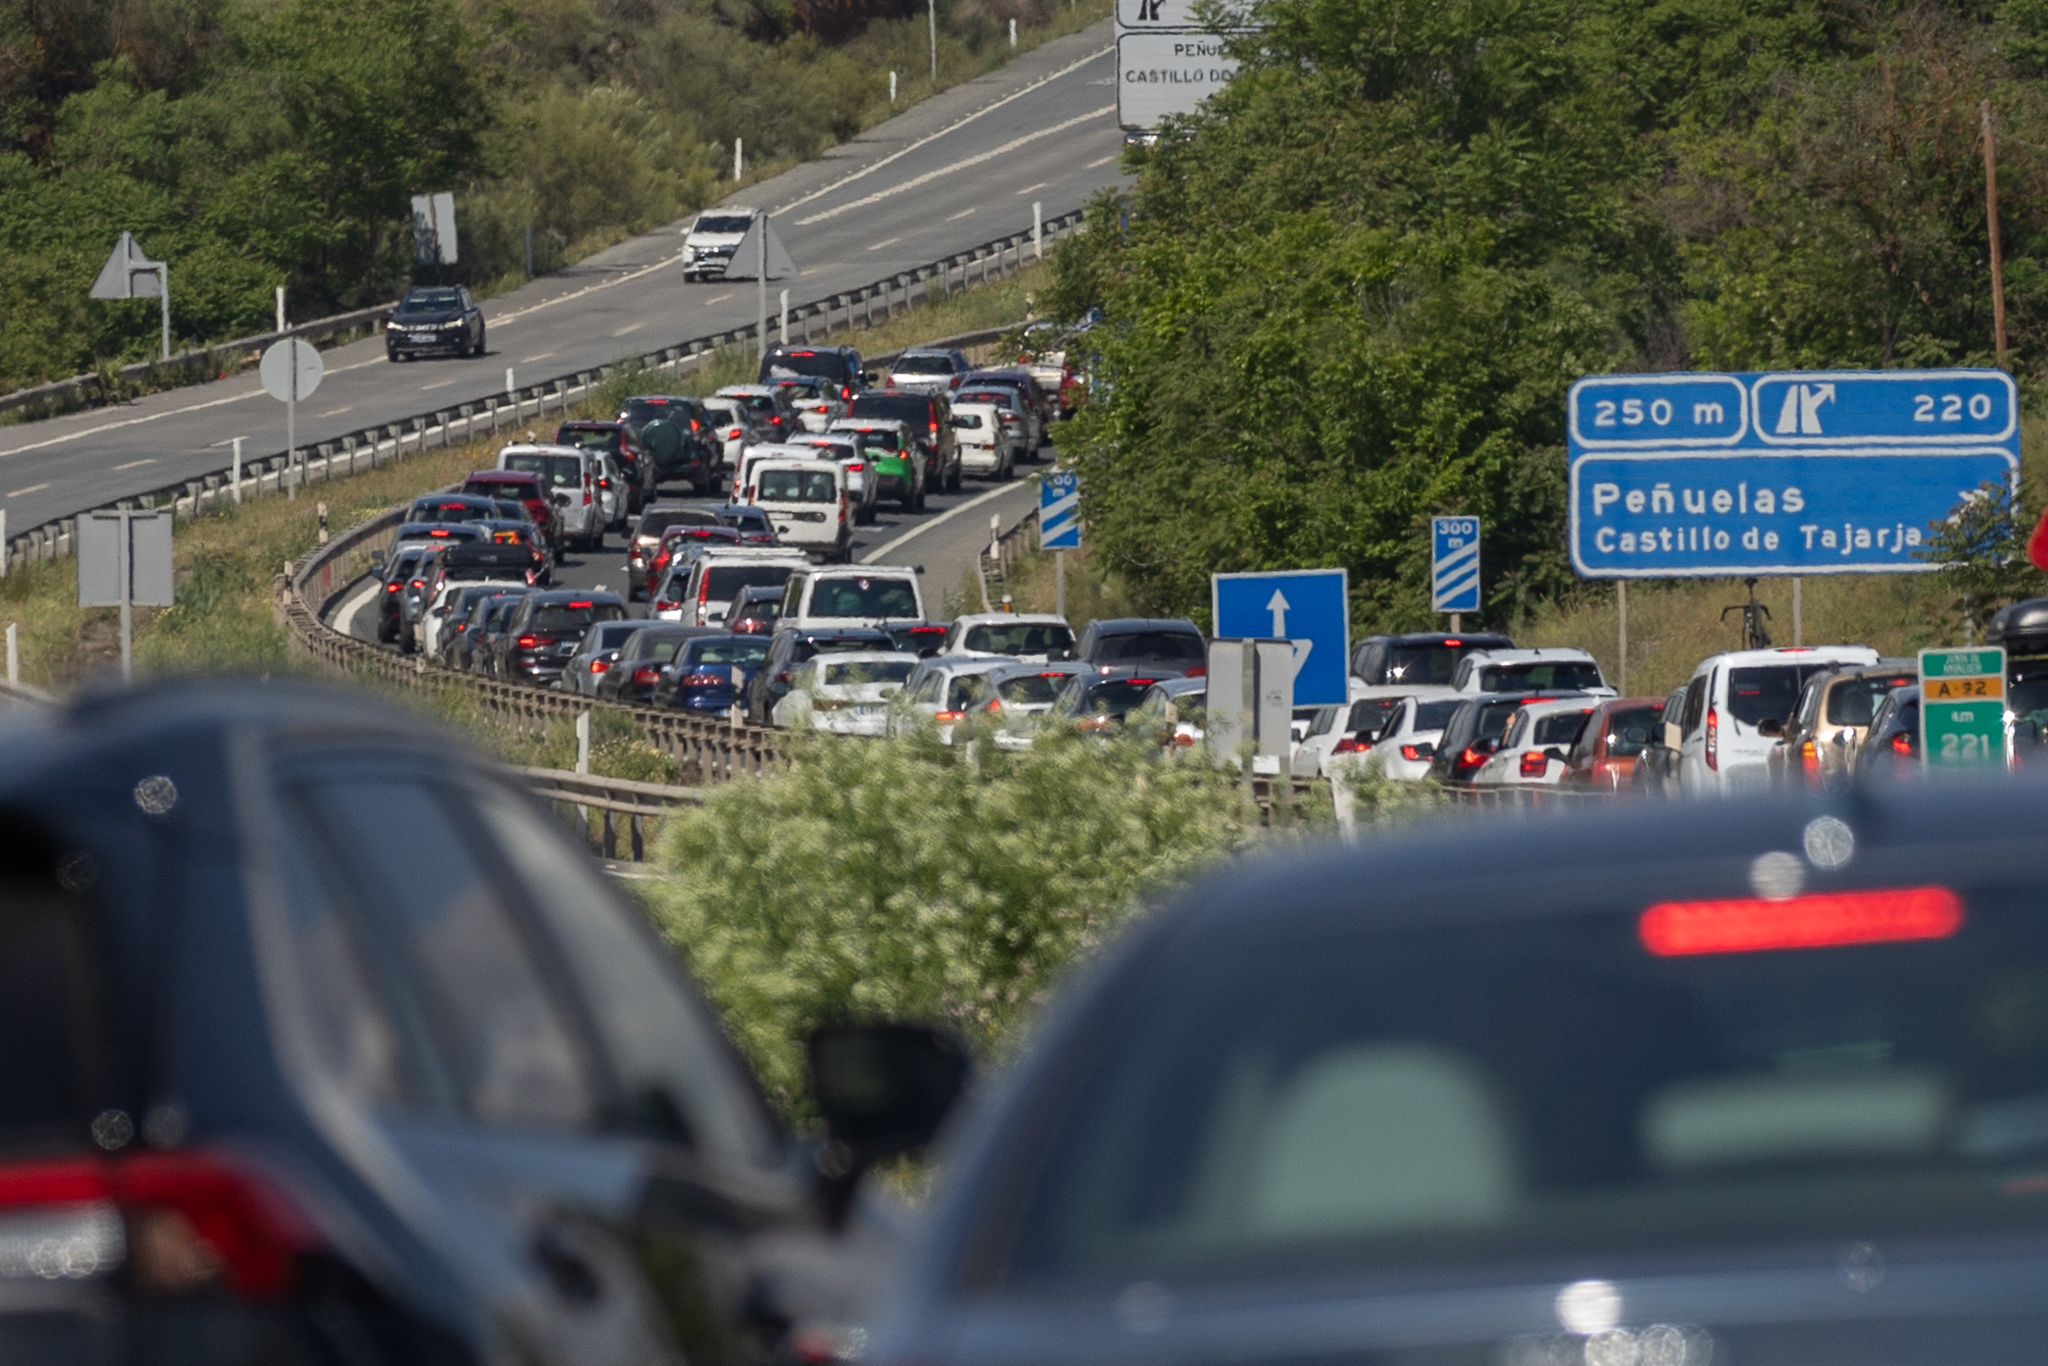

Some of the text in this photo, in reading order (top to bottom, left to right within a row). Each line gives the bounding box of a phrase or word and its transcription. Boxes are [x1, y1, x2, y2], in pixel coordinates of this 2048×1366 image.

[1126, 69, 1204, 84] CASTILLO
[1594, 398, 1725, 427] 250 m
[1914, 394, 1992, 422] 220
[1048, 475, 1073, 486] 00
[1593, 482, 1805, 516] Peñuelas
[1439, 521, 1474, 535] 300
[1596, 522, 1923, 556] Castillo de Tajarja
[1938, 681, 1987, 698] A-92
[1941, 733, 1989, 759] 221
